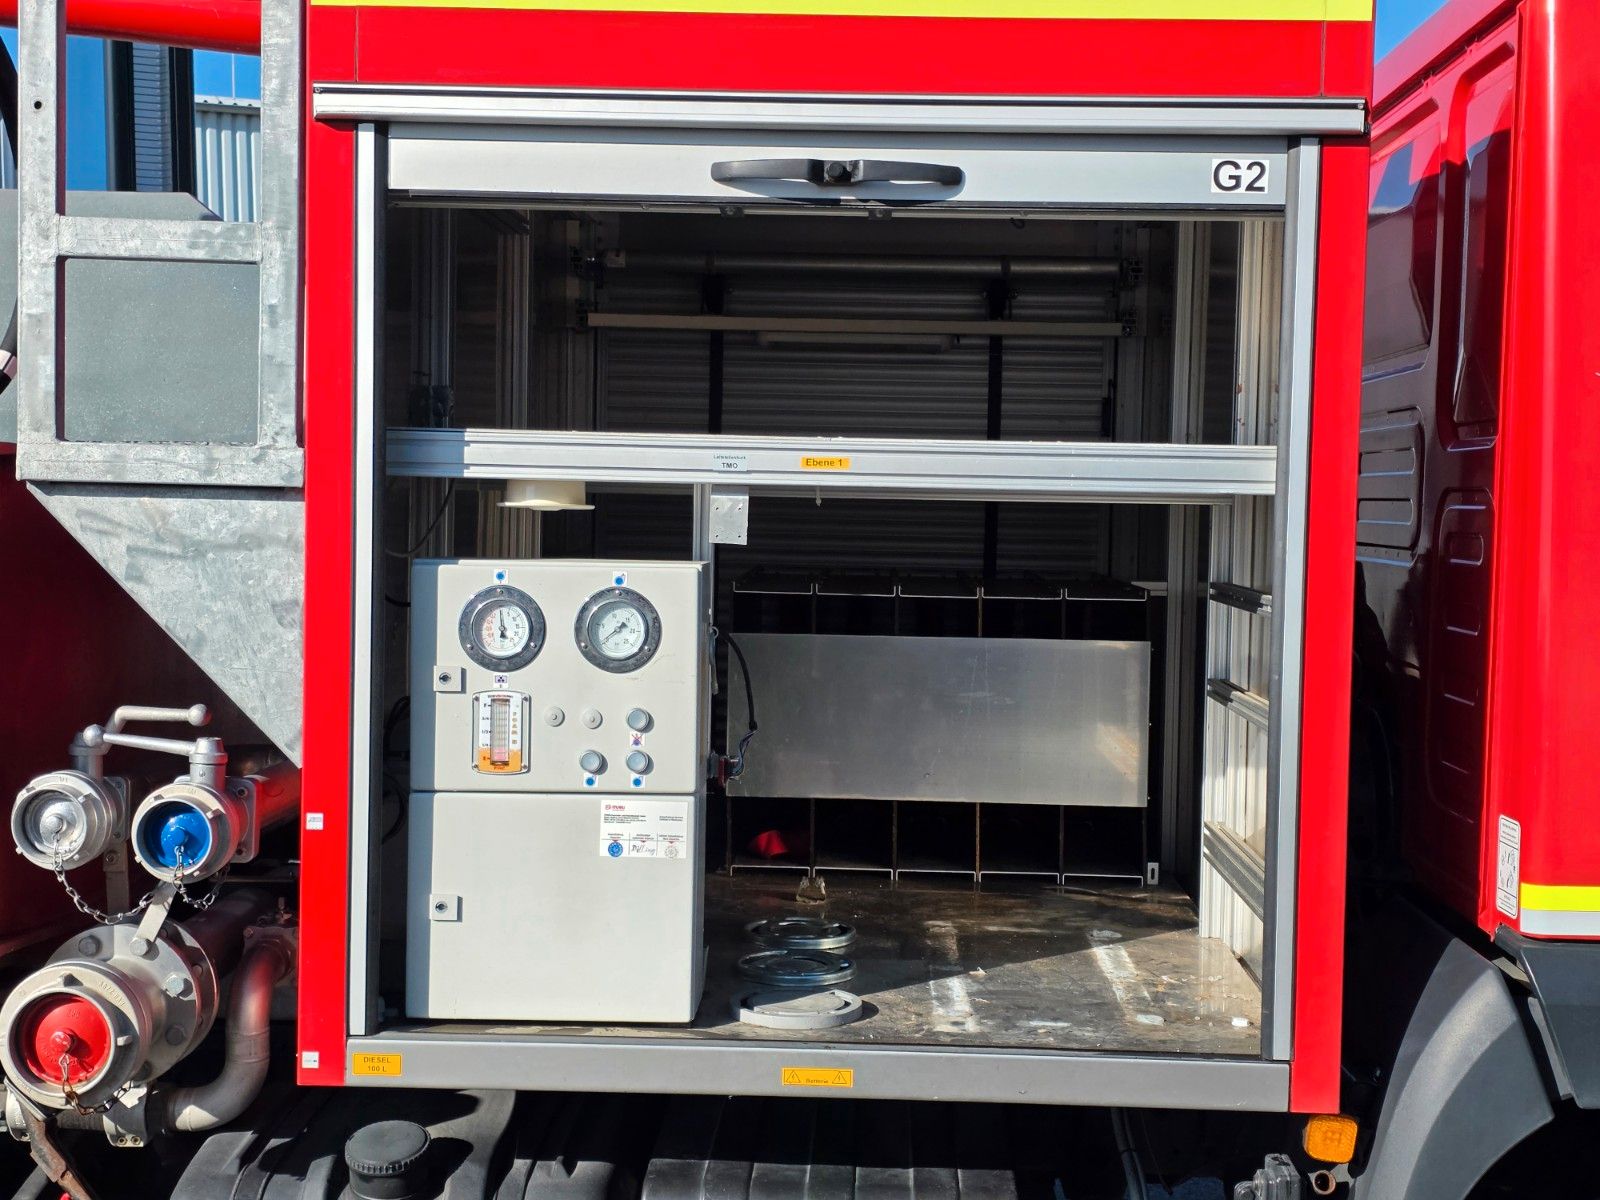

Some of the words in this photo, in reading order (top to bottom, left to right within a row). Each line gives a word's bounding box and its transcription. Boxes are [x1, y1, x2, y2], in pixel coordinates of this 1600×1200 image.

[1213, 160, 1267, 192] G2
[805, 458, 835, 467] Ebene
[363, 1056, 391, 1064] DIESEL
